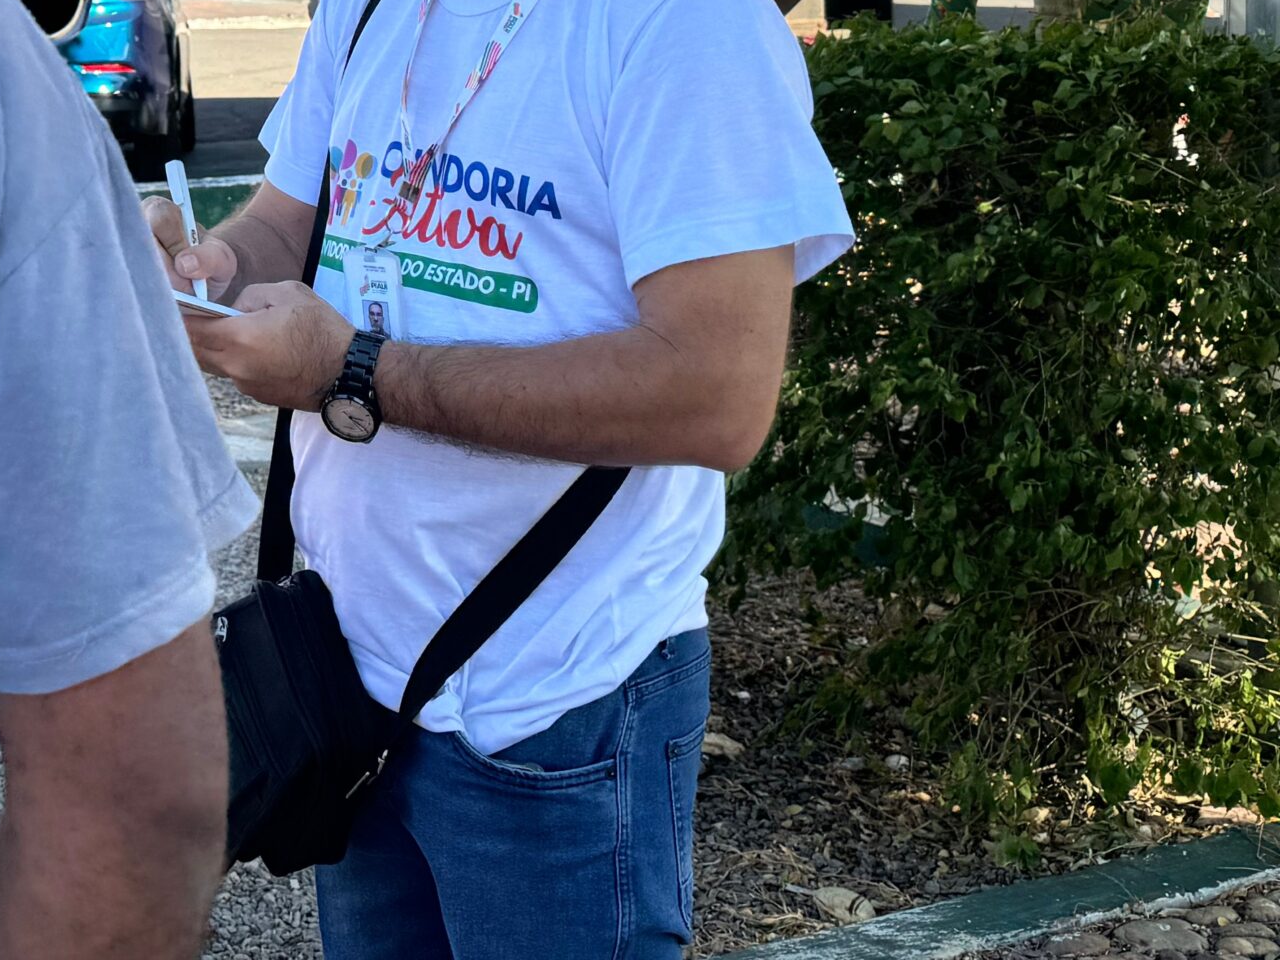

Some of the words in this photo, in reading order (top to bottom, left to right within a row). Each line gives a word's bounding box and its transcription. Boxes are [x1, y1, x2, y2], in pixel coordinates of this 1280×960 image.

[401, 258, 422, 278] DO
[423, 263, 495, 295] ESTADO
[511, 280, 532, 302] PI
